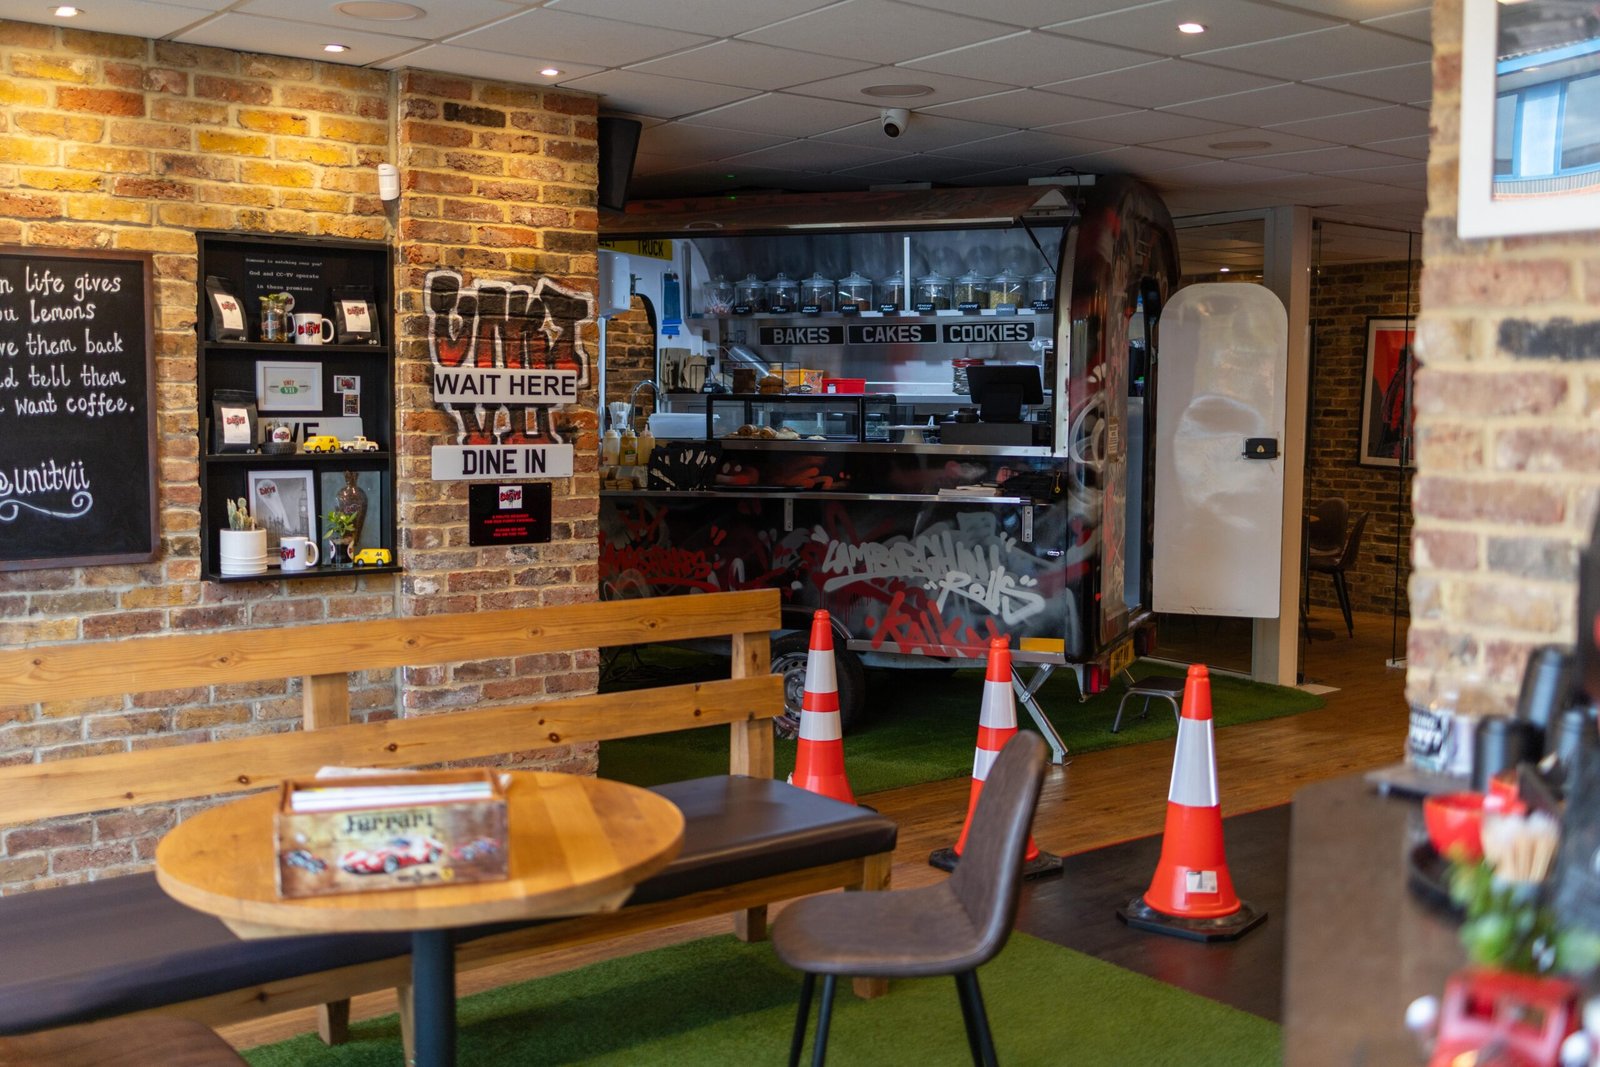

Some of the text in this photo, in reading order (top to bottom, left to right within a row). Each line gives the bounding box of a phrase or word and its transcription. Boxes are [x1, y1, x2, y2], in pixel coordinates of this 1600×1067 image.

[637, 240, 664, 256] TRUCK
[74, 271, 122, 301] gives
[26, 332, 77, 356] them
[85, 327, 124, 354] back
[773, 328, 830, 344] BAKES
[862, 325, 922, 343] CAKES
[949, 324, 1028, 342] COOKIES
[28, 364, 72, 387] tell
[80, 364, 126, 387] them
[435, 374, 575, 396] WAIT HERE
[66, 392, 135, 417] coffee.
[462, 449, 546, 475] DINE IN
